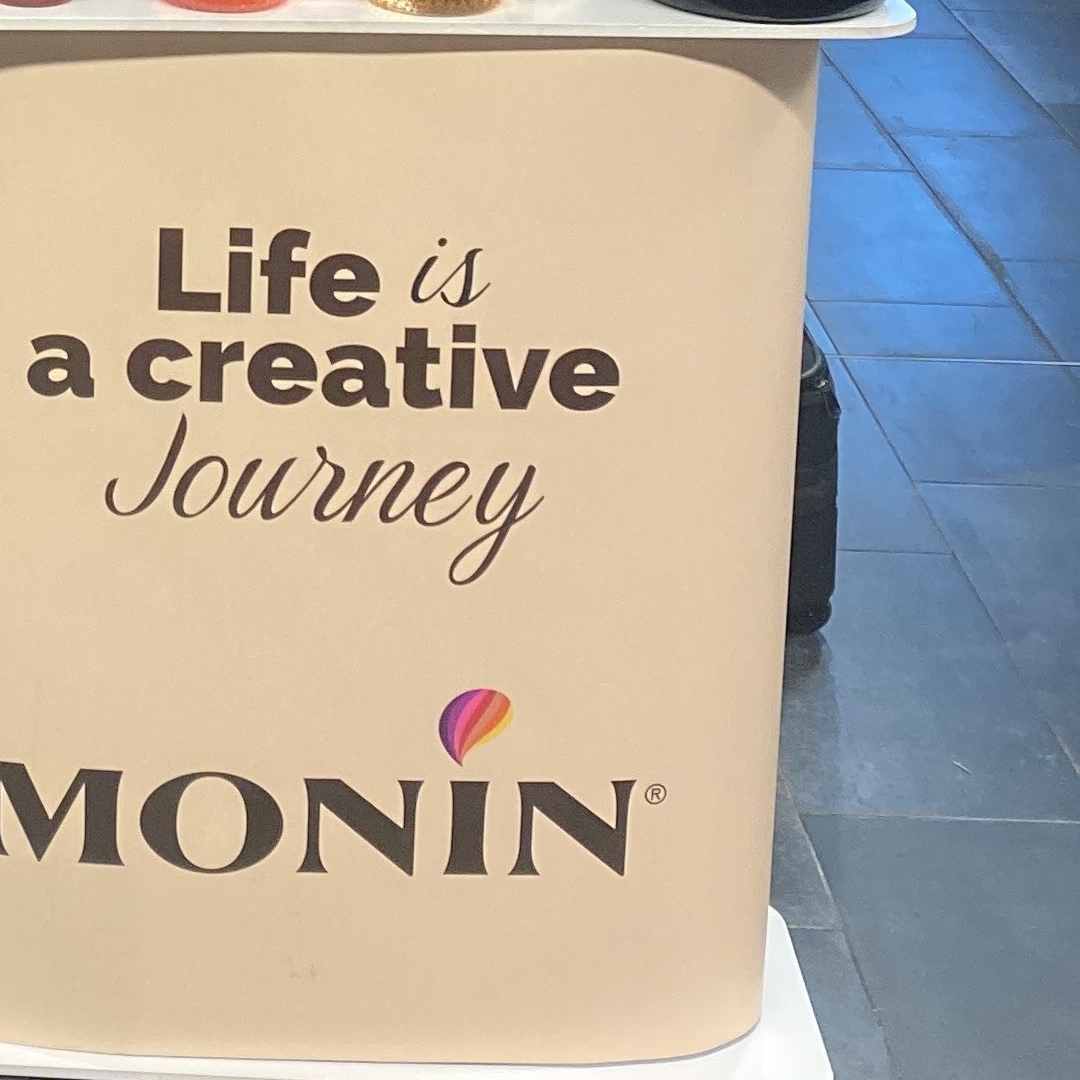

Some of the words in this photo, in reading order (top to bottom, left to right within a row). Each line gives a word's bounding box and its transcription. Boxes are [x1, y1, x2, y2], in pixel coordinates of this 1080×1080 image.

[157, 227, 381, 317] Life
[410, 237, 490, 308] is
[26, 333, 95, 399] a
[126, 324, 619, 411] creative
[104, 412, 544, 586] Journey
